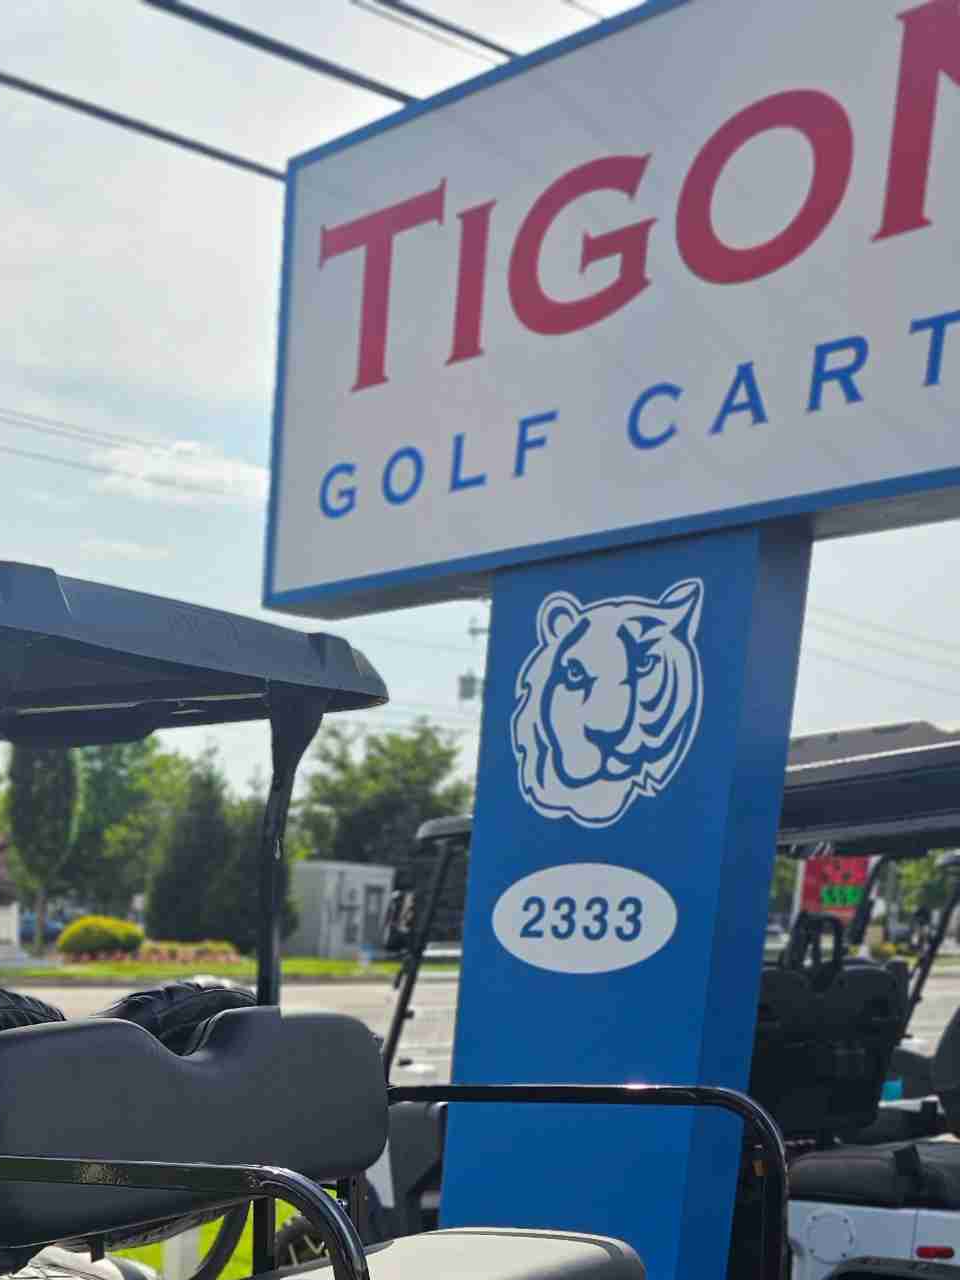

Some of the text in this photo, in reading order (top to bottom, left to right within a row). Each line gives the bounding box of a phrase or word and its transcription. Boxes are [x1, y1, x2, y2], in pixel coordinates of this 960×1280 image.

[319, 310, 960, 519] GOLF CART
[519, 895, 644, 942] 2333
